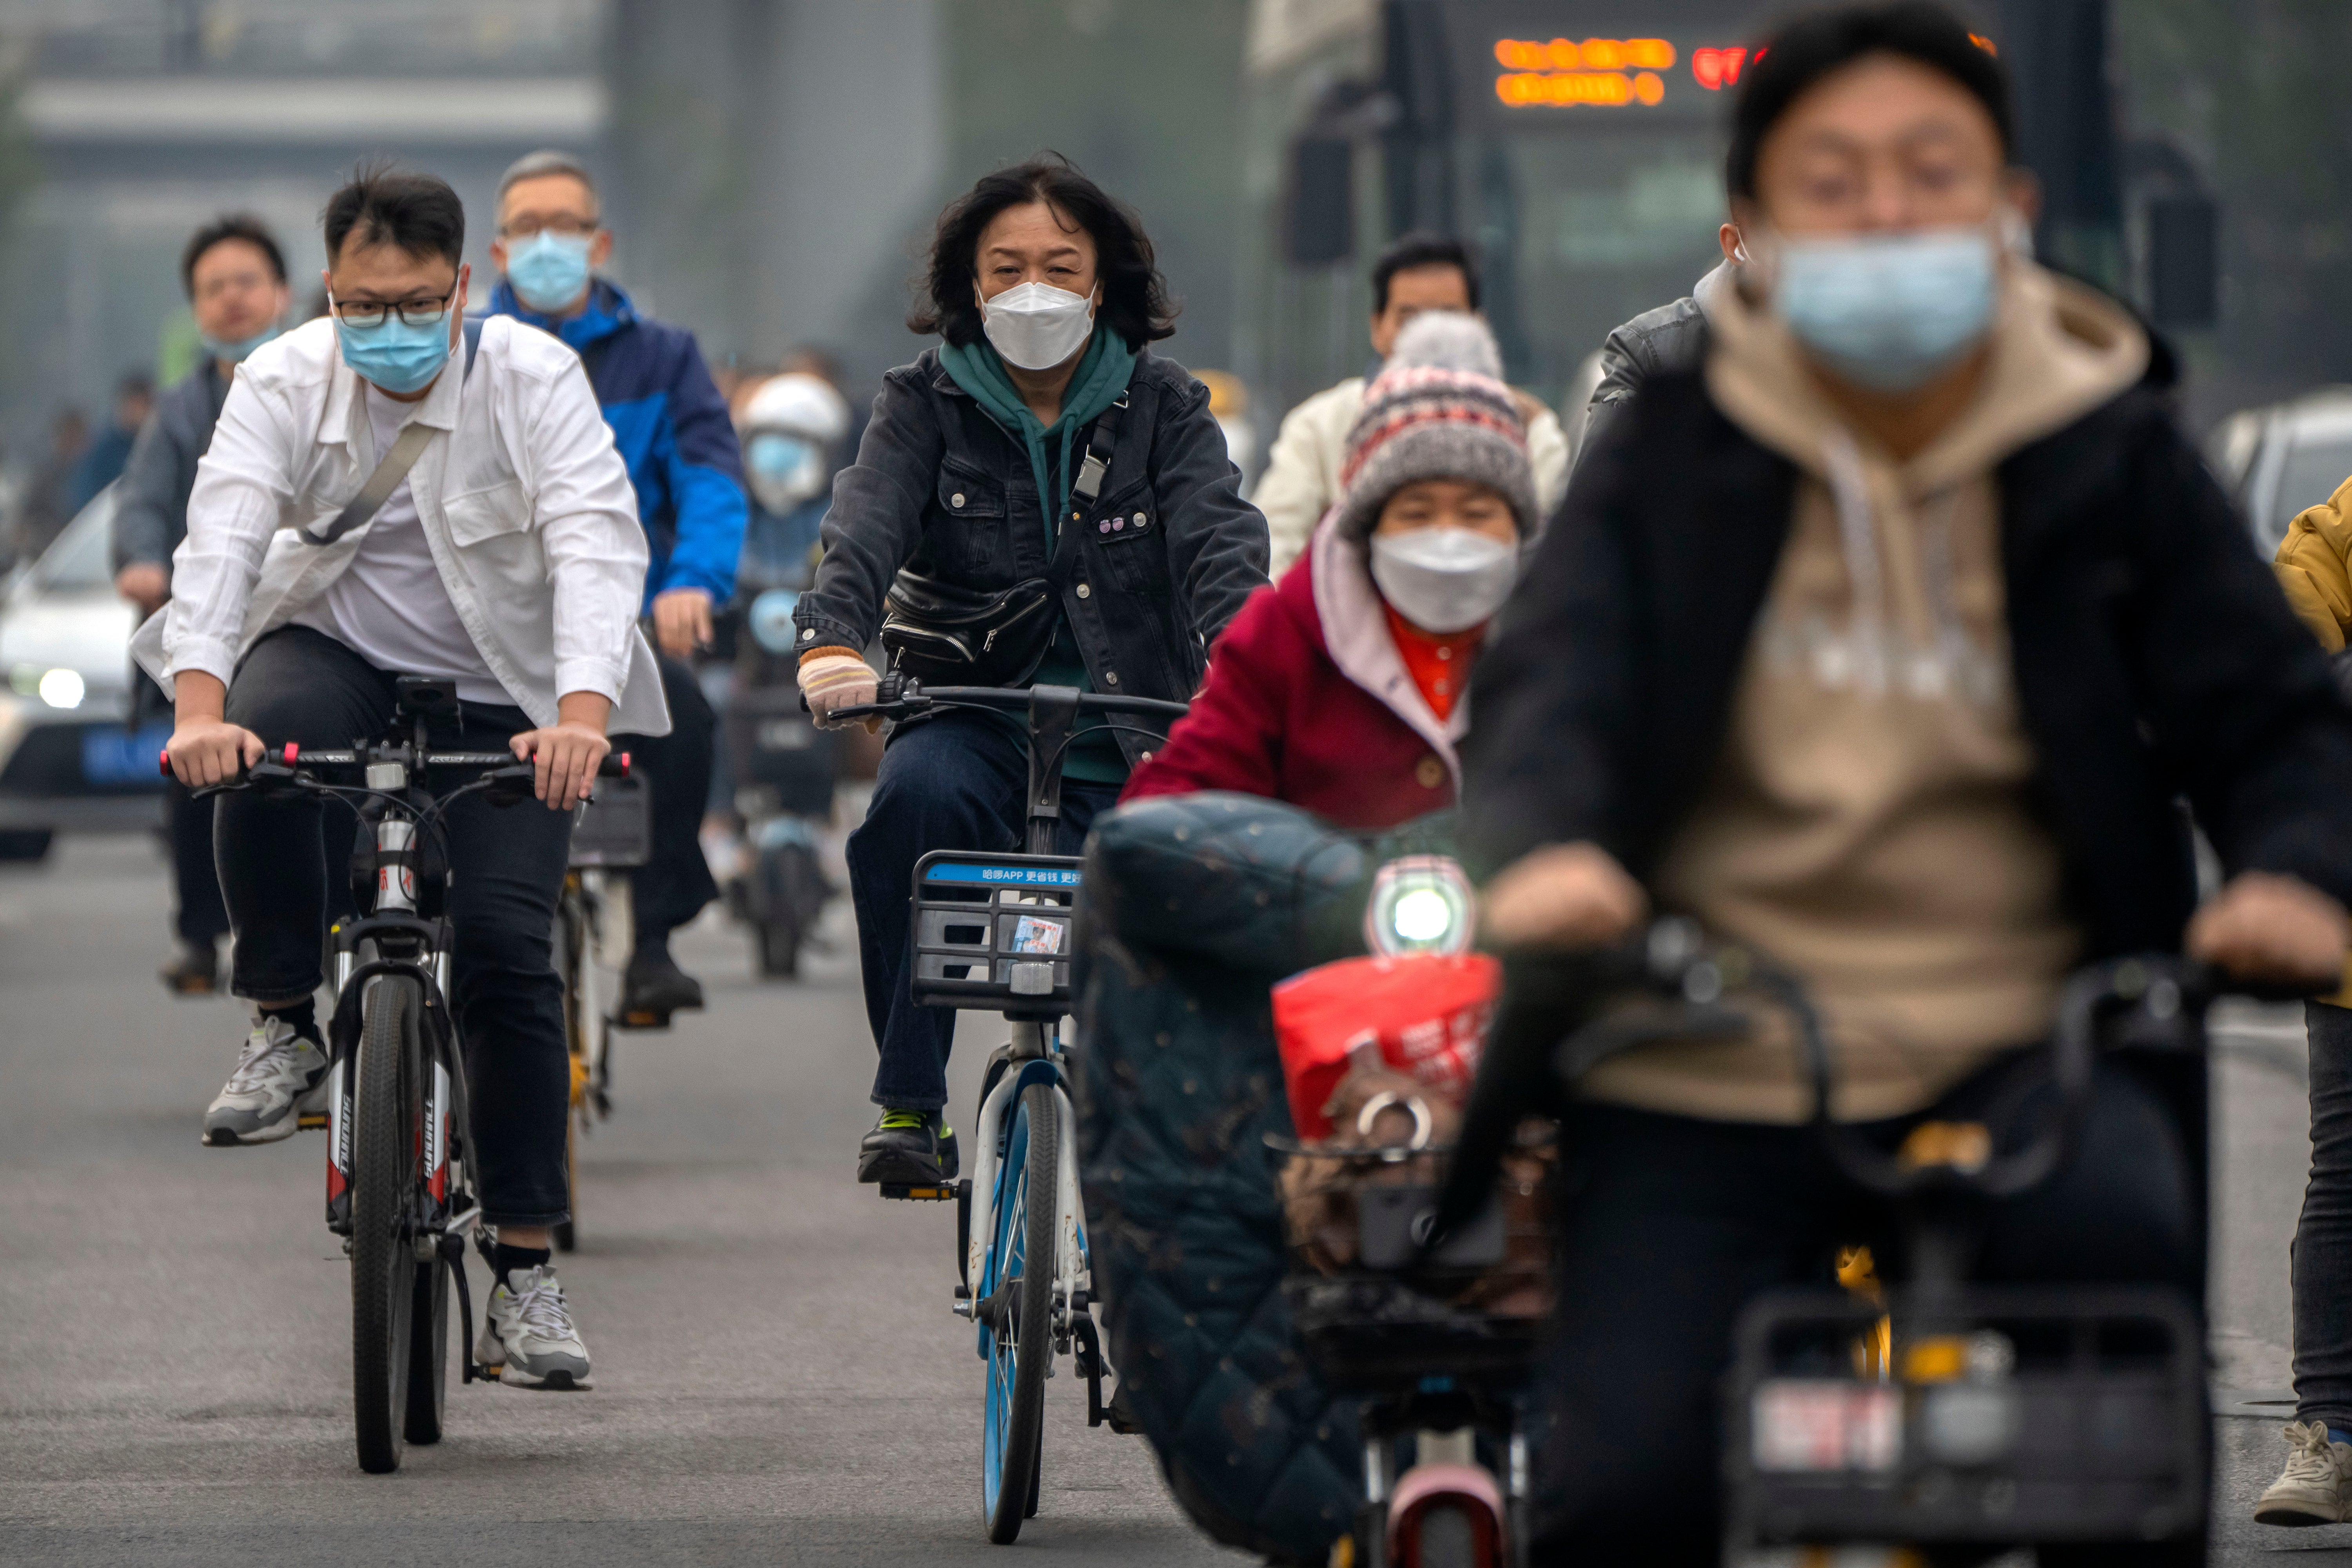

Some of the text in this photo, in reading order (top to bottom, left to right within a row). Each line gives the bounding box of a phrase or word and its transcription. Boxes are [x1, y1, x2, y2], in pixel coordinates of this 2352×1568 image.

[982, 869, 1024, 880] 哈啰APP
[1026, 871, 1058, 882] 更省钱
[424, 1099, 433, 1179] SUNDANCE
